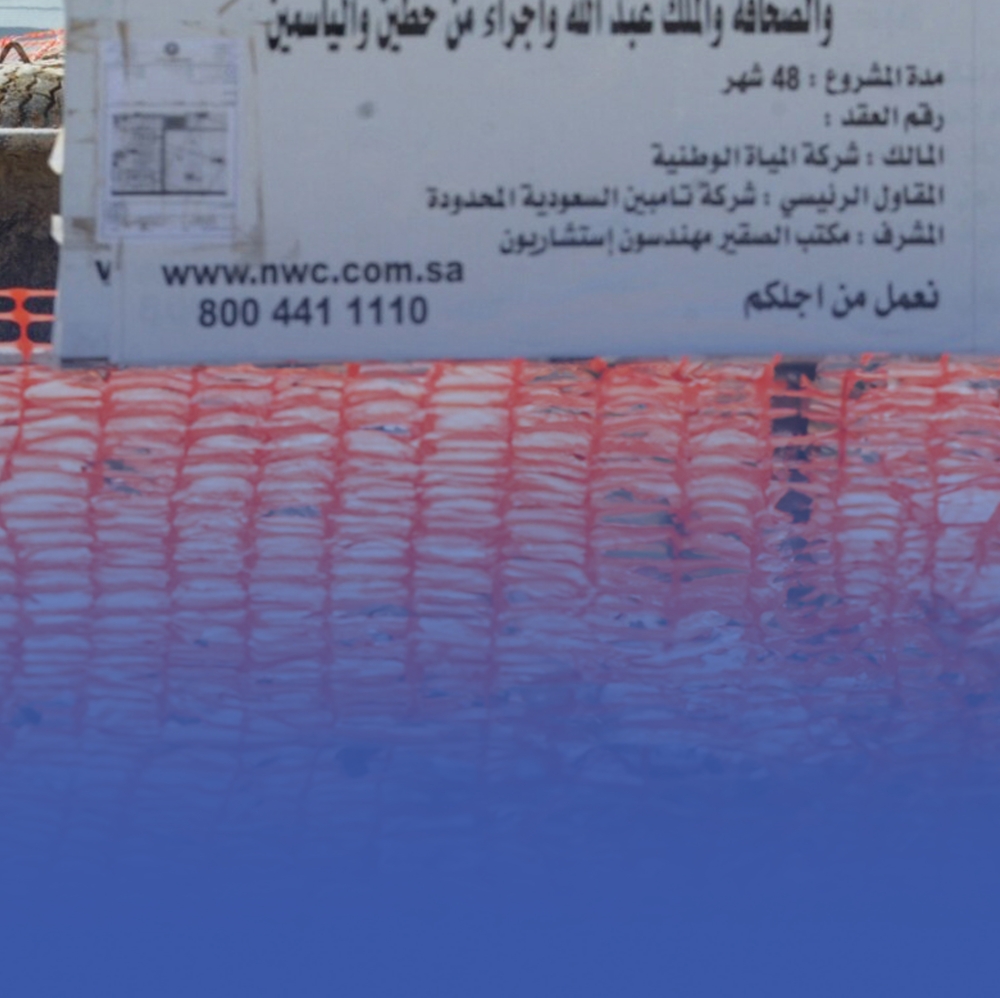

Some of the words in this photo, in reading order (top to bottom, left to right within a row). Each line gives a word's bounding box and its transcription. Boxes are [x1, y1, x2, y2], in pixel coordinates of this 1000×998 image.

[722, 63, 764, 95] شهر
[770, 64, 801, 92] 48
[825, 62, 902, 96] المشروع
[905, 64, 945, 88] مدة
[840, 103, 899, 128] العقد
[903, 102, 945, 133] رقم
[651, 142, 740, 176] الوطنية
[802, 141, 860, 174] شركة
[882, 144, 944, 167] المالك
[426, 186, 516, 216] المحدودة
[521, 183, 619, 217] السعودية
[698, 181, 757, 214] شركة
[779, 184, 869, 219] الرئيسي
[873, 182, 945, 214] المقاول
[618, 224, 713, 254] مهندسون
[794, 222, 851, 253] مكتب
[872, 220, 945, 253] المشرف
[160, 260, 465, 287] www.nwc.com.sa
[197, 297, 261, 329] 800
[270, 296, 330, 327] 441
[346, 294, 429, 326] 1110
[830, 283, 868, 320] من
[873, 280, 940, 319] نعمل
